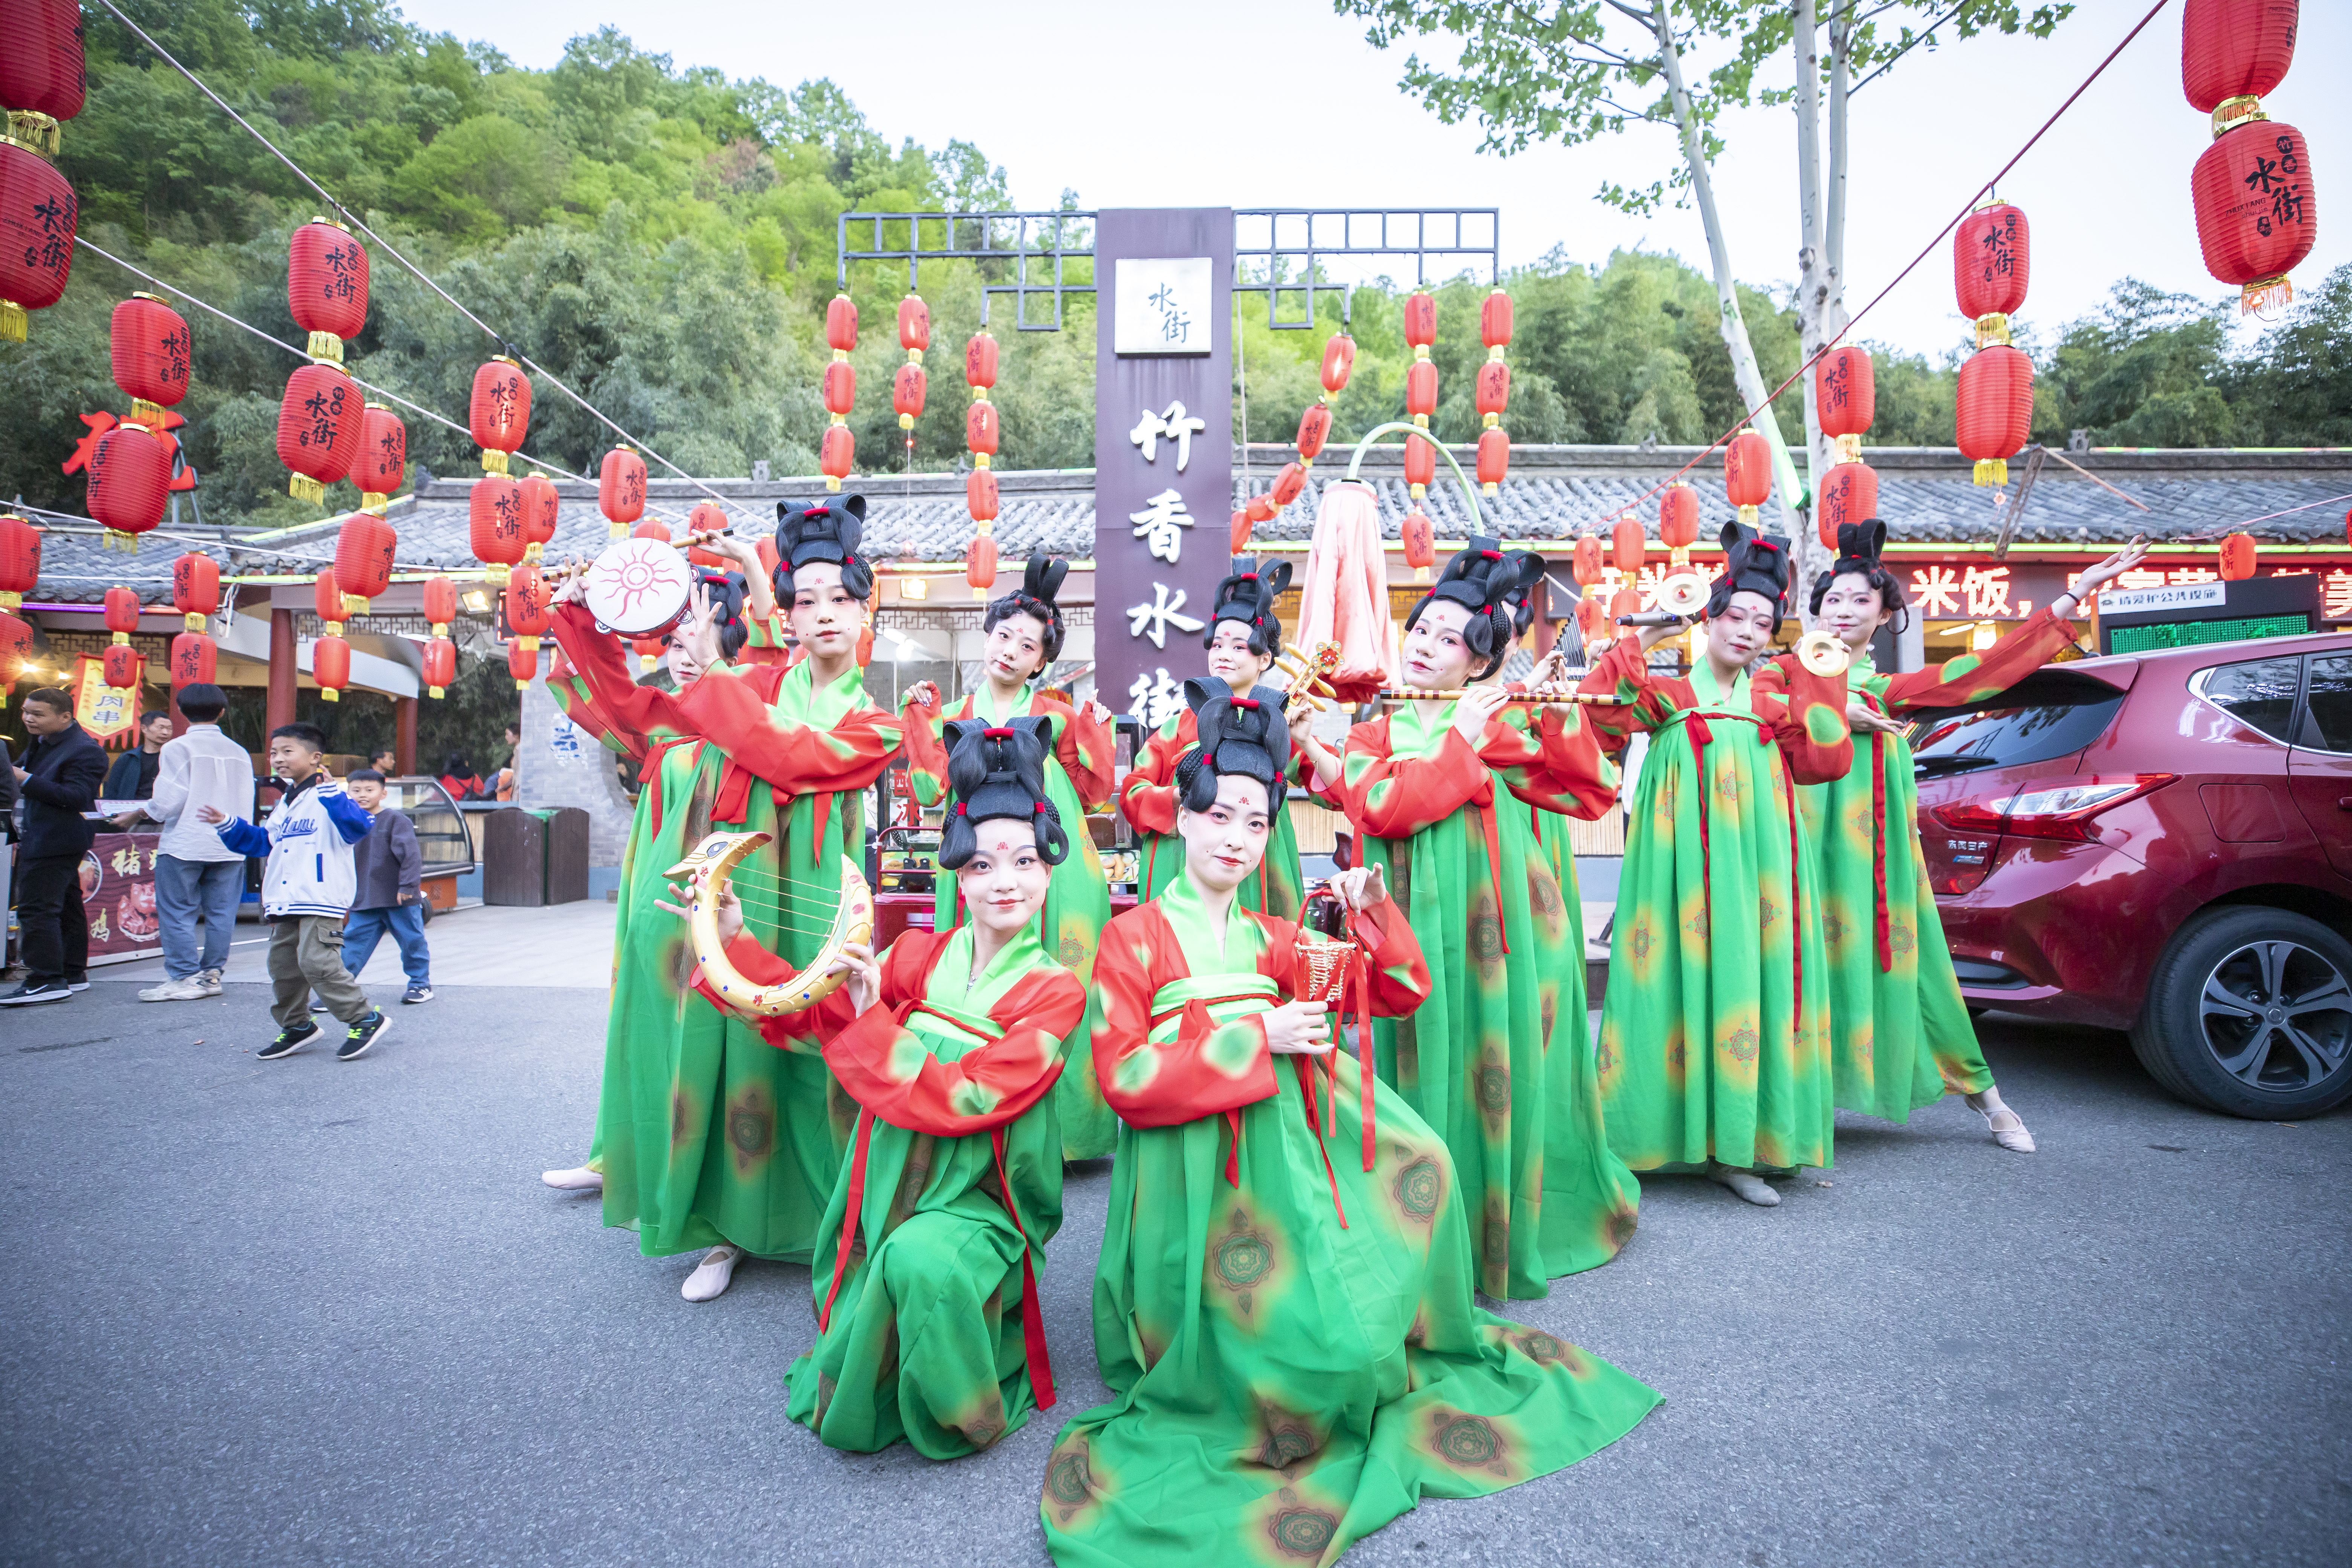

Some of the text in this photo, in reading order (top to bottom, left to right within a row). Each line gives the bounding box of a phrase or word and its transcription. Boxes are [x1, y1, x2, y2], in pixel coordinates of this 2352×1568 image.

[2276, 136, 2298, 174] 竹香
[2244, 156, 2304, 226] 水街
[33, 194, 67, 277] 水街
[1983, 225, 2017, 277] 水街
[325, 246, 356, 303] 水街
[1148, 282, 1191, 343] 水街
[161, 331, 187, 385] 水街
[490, 381, 515, 427] 水街
[1825, 369, 1849, 407] 水街
[305, 390, 337, 450] 水街
[381, 432, 401, 476] 水街
[626, 469, 642, 506] 水街
[1827, 485, 1847, 525] 水街
[495, 494, 520, 539] 水街
[1662, 501, 1675, 528] 水街
[1413, 529, 1427, 555] 水街
[1127, 400, 1206, 729] 竹香水街
[518, 585, 539, 619] 水街
[2119, 589, 2217, 606] 请爱护公共设施
[1948, 839, 1988, 851] 东风日产
